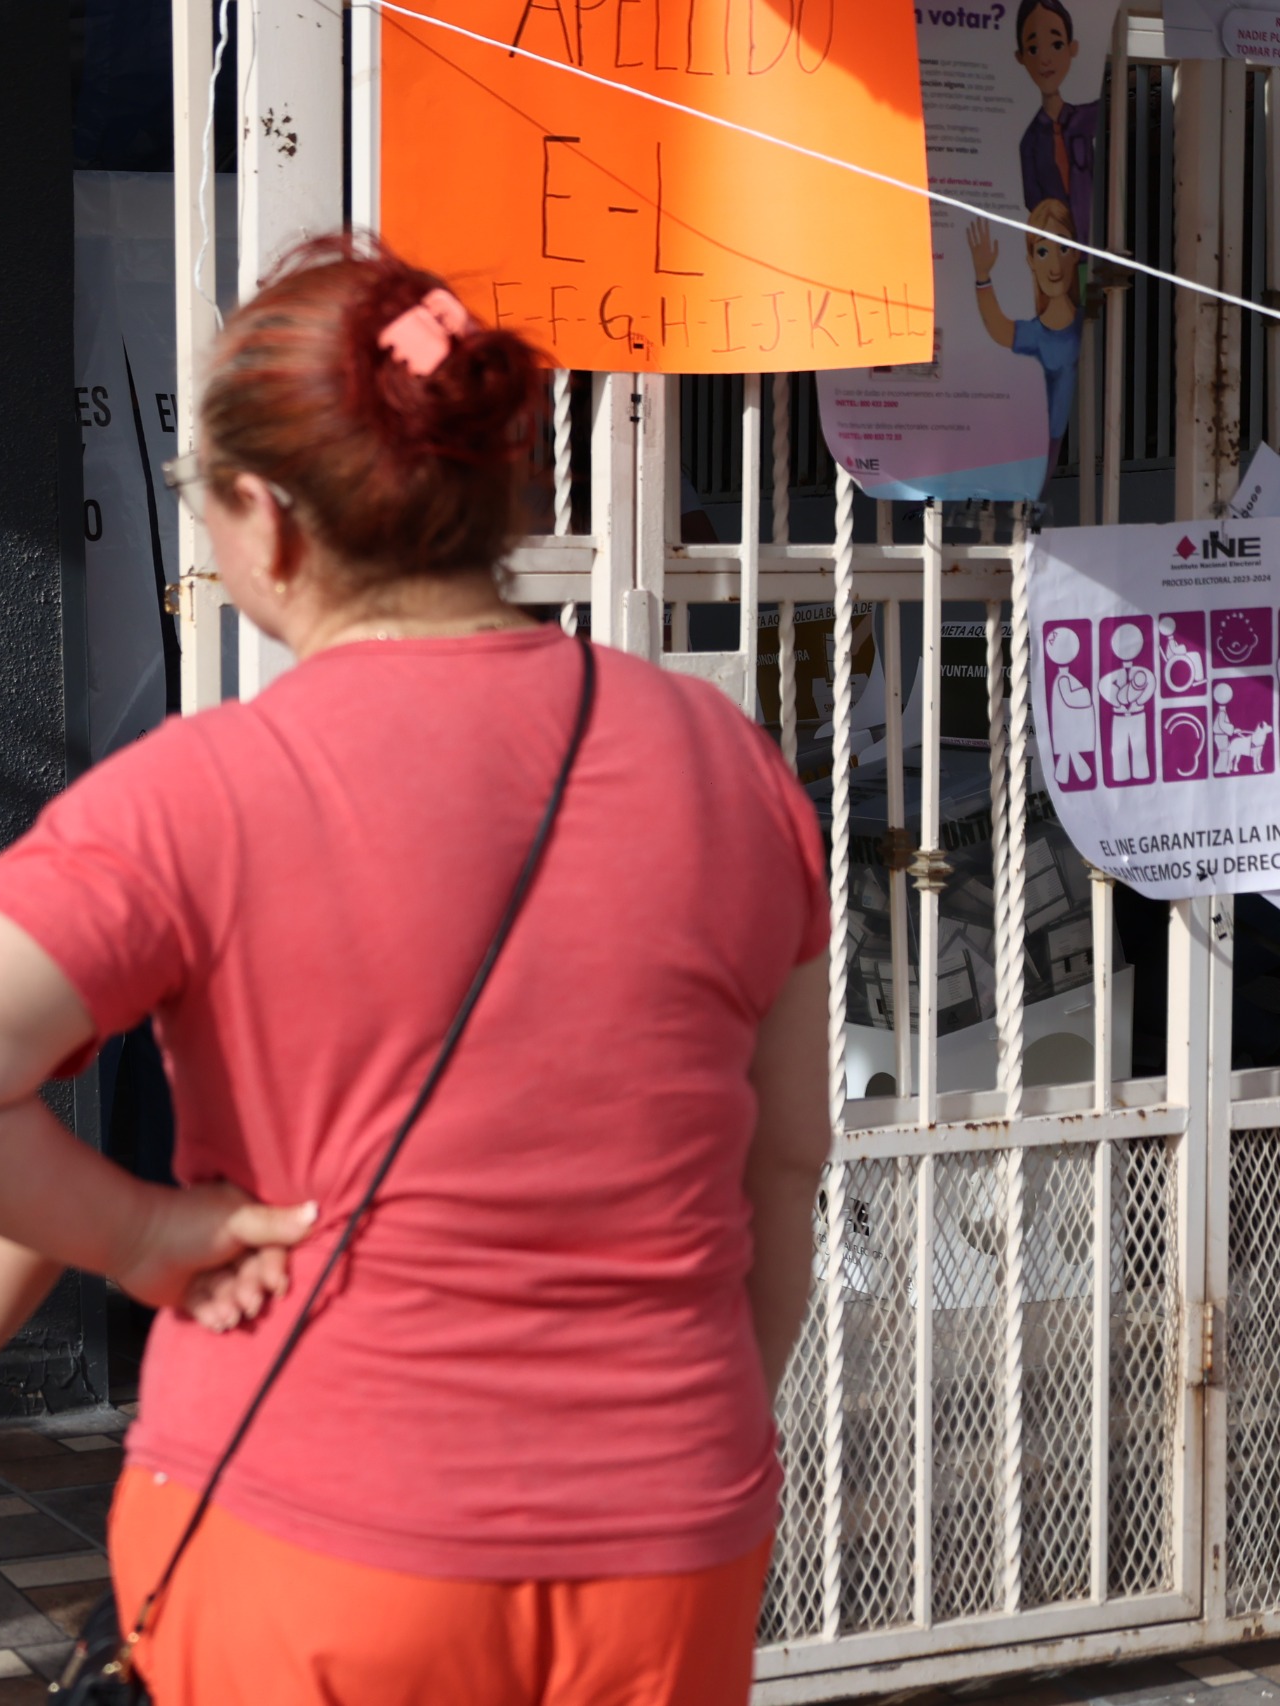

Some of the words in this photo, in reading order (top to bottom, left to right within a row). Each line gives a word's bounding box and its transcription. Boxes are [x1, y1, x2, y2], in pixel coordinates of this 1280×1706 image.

[928, 3, 1005, 30] votar?
[1237, 29, 1268, 42] NADIE
[1236, 44, 1270, 57] TOMAR
[854, 458, 880, 471] INE
[1202, 537, 1261, 560] INE
[1170, 563, 1198, 571] Instituto
[1161, 578, 1194, 587] PROCESO
[1194, 576, 1231, 586] ELECTORAL
[1233, 574, 1272, 584] 2023-2024
[814, 609, 825, 619] LA
[861, 602, 873, 613] DE
[940, 626, 966, 636] META
[967, 626, 986, 637] AQU
[1099, 840, 1117, 857] EL
[1116, 838, 1137, 856] INE
[1138, 828, 1234, 854] GARANTIZA
[1239, 826, 1261, 844] LA
[1195, 859, 1219, 878] SU
[1223, 853, 1280, 874] DEREC
